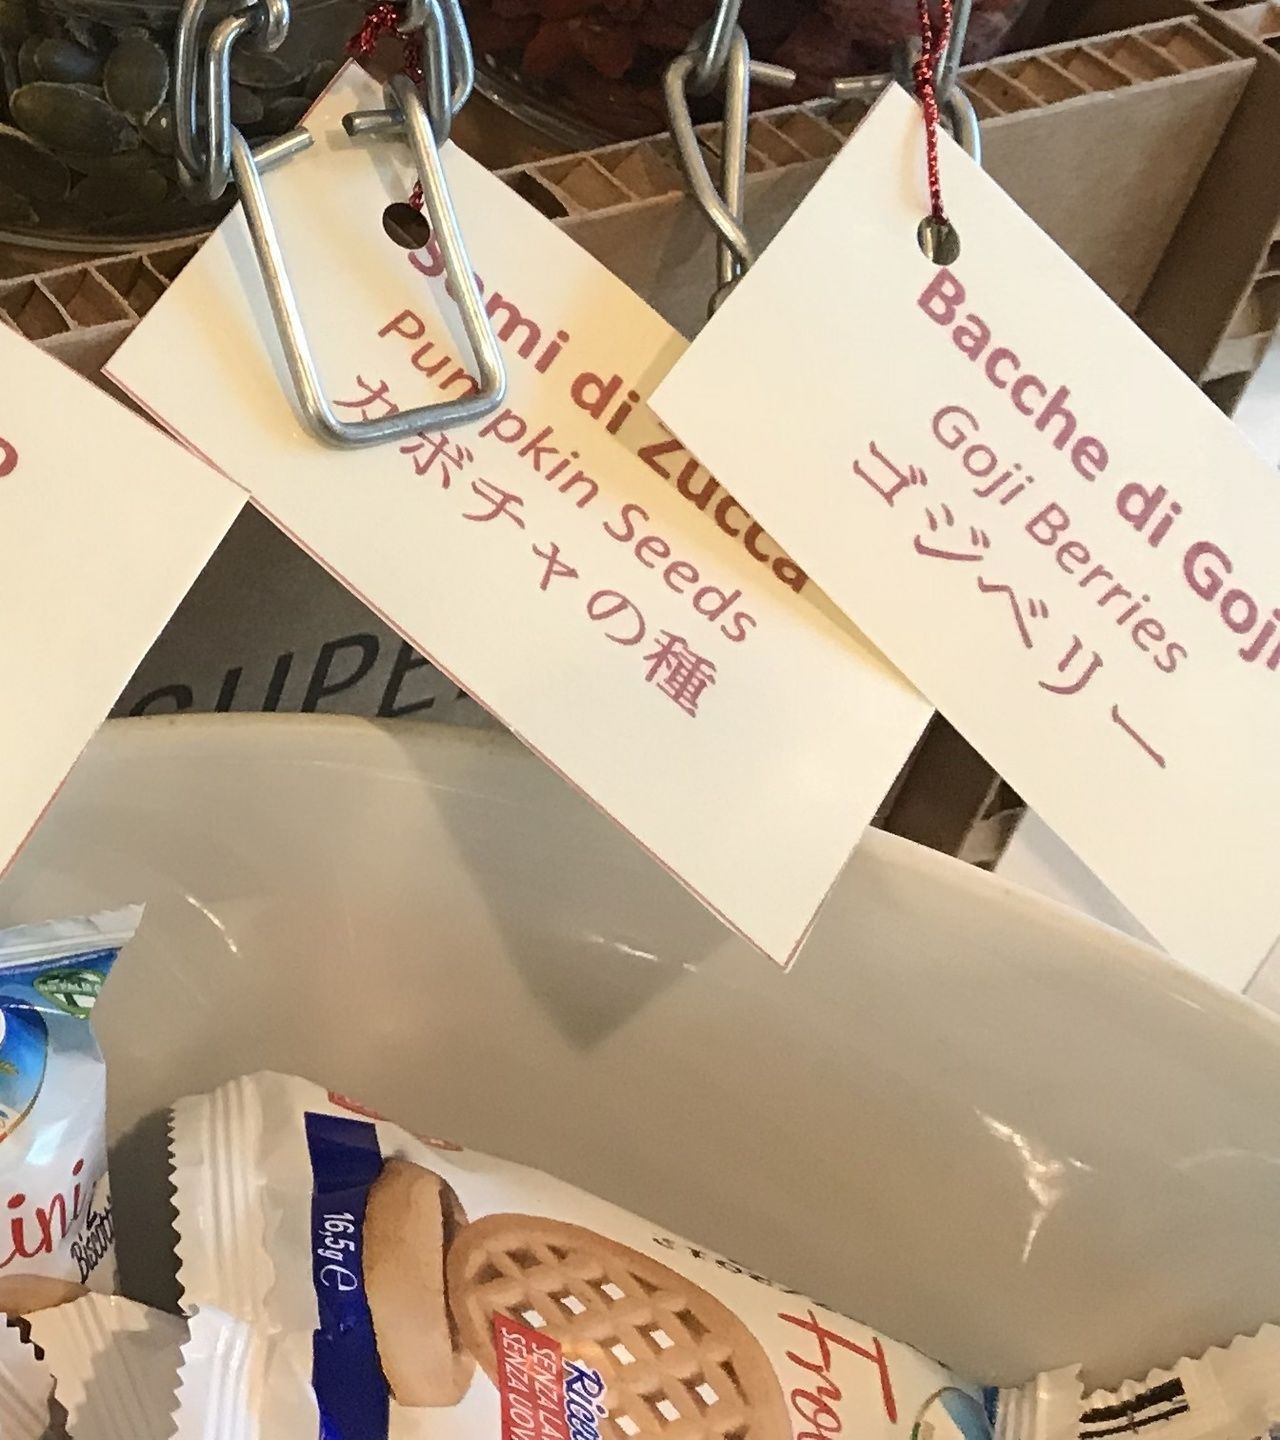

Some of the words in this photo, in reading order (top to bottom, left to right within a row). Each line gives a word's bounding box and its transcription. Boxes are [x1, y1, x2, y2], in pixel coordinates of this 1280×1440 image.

[408, 232, 571, 375] Smi
[570, 371, 640, 435] di
[916, 266, 1109, 482] Bacche
[1115, 481, 1183, 548] di
[603, 503, 757, 644] Seeds
[931, 405, 1034, 506] Goji
[1024, 501, 1188, 674] Berries
[852, 441, 1166, 768] ゴジベリー
[128, 632, 471, 717] UPE
[318, 1210, 356, 1264] 16,5g
[501, 1327, 530, 1393] SENZA
[531, 1341, 559, 1412] SENZA
[508, 1392, 537, 1440] UOV
[539, 1408, 564, 1440] LA
